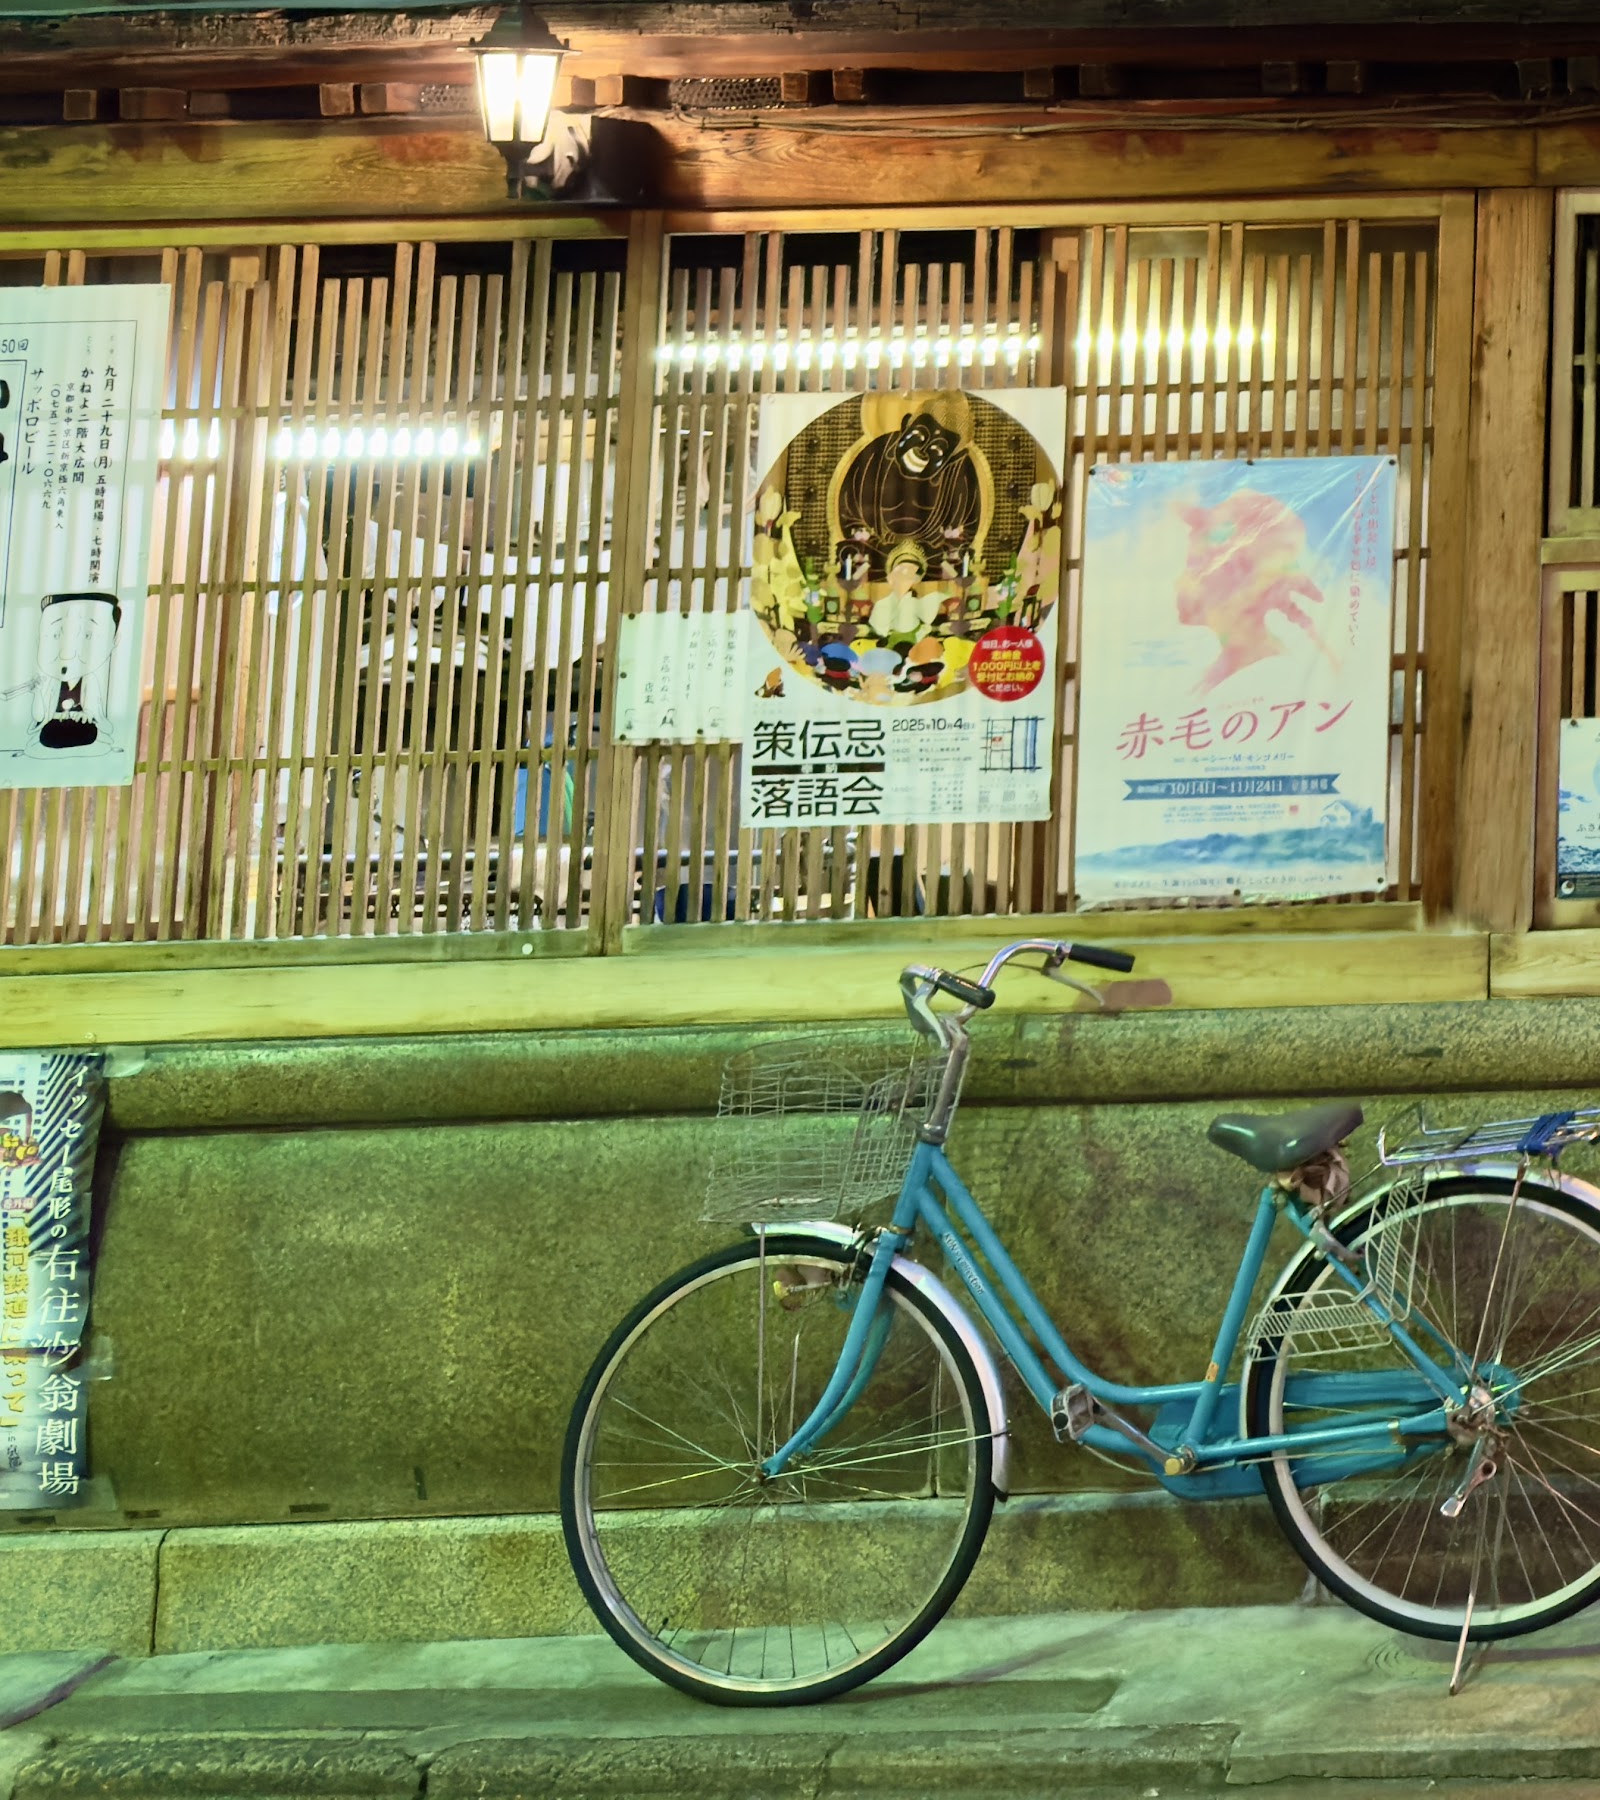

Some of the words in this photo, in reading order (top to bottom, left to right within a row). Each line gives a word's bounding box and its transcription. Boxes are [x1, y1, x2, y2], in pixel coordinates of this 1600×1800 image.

[21, 367, 44, 475] サッポロビール
[72, 366, 94, 484] かねよ二階大広間
[752, 719, 886, 761] 策伝忌
[1116, 700, 1354, 760] 赤毛のアン
[751, 775, 885, 819] 落語会
[34, 1065, 89, 1496] イッセー尾形の右往沙翁劇場
